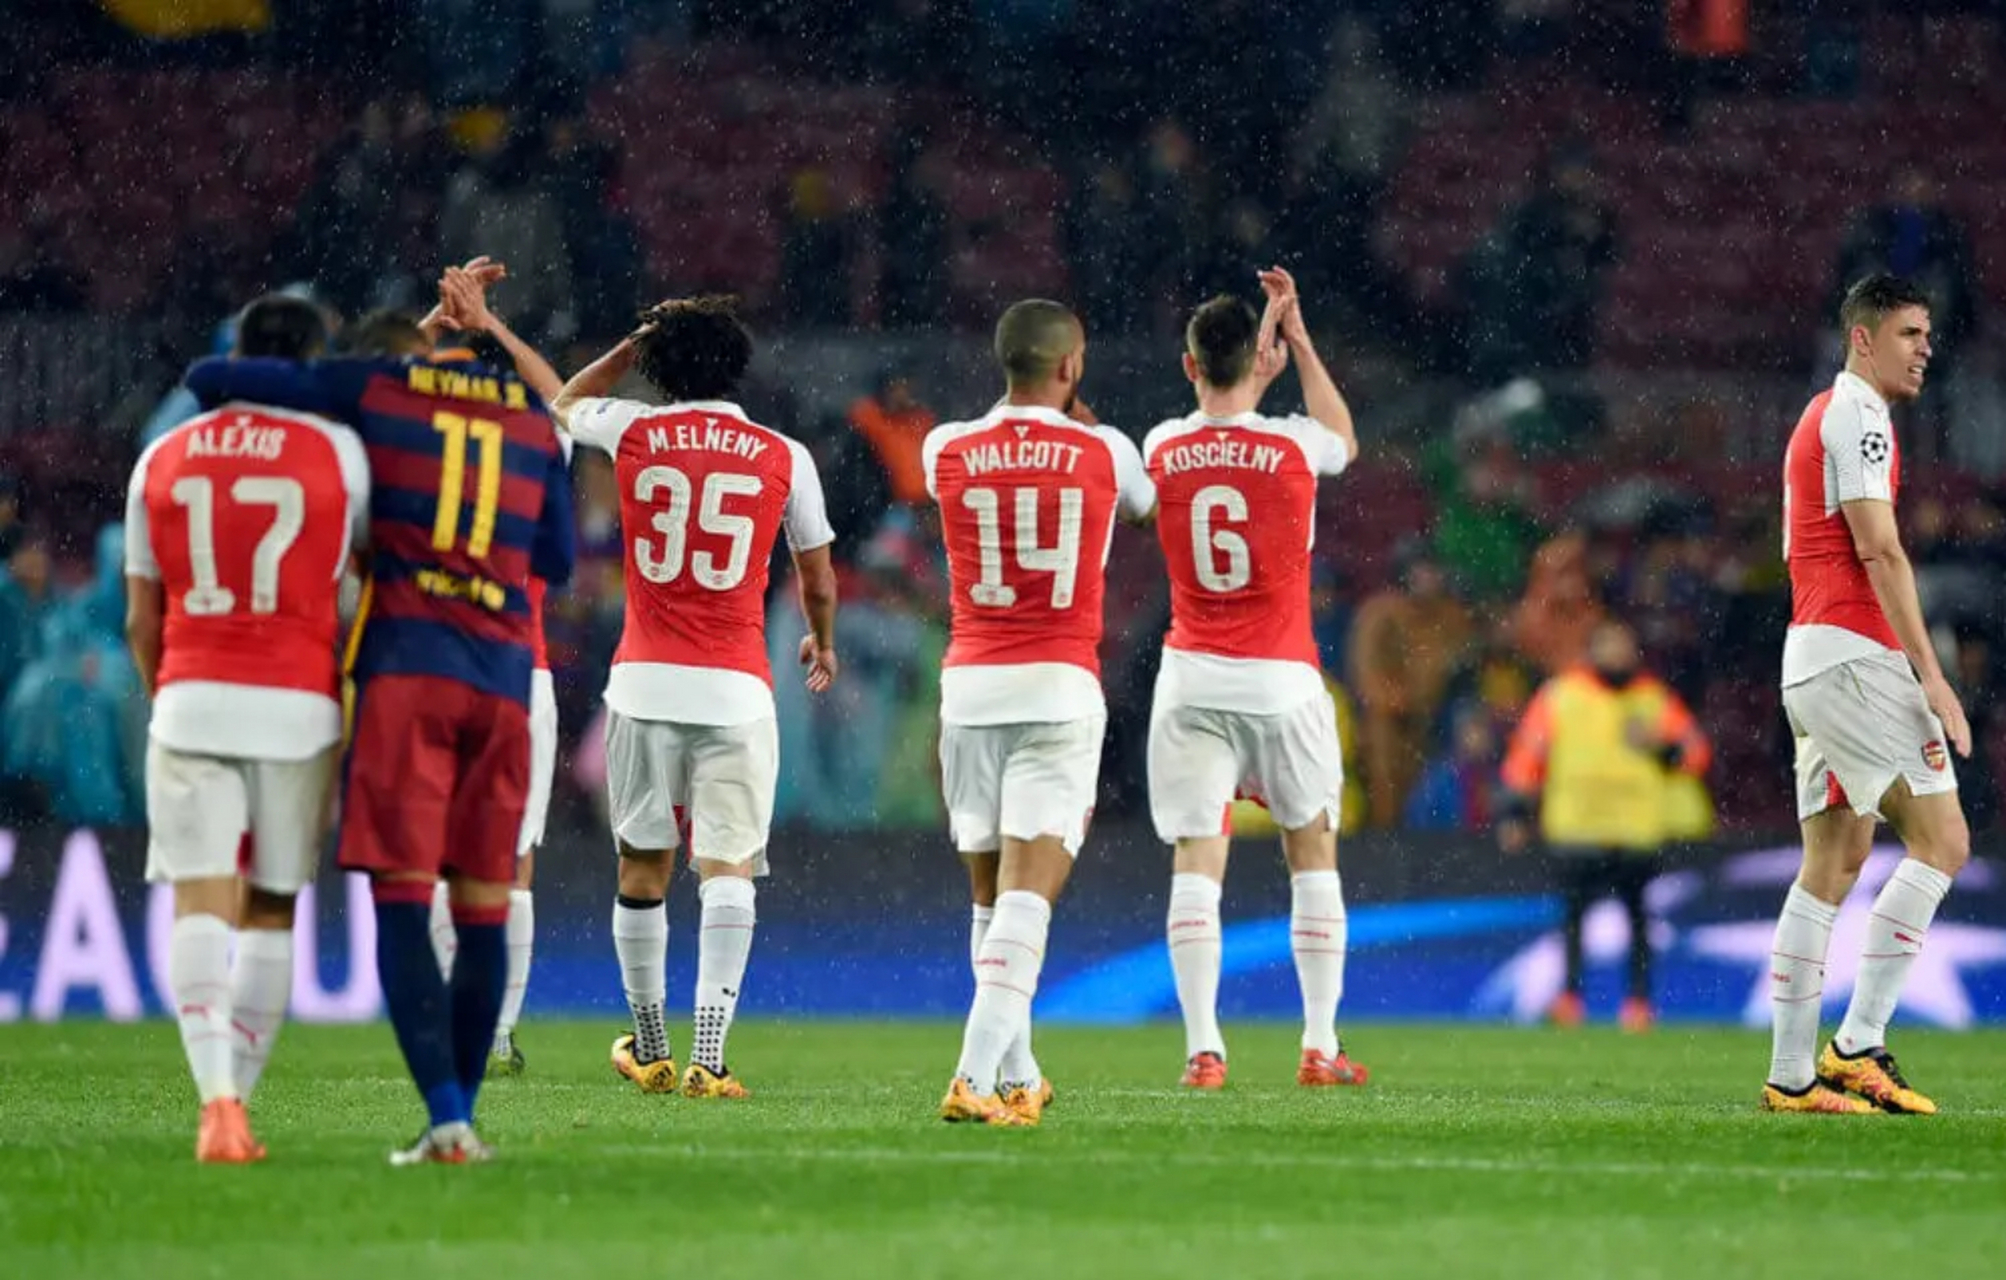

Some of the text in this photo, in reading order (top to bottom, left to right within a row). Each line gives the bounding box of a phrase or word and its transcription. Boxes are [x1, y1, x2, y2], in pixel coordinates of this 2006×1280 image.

[408, 366, 500, 403] NEYMAR
[186, 425, 285, 460] ALEXIS
[432, 410, 502, 558] 11
[962, 440, 1083, 476] WALCOTT
[1163, 440, 1284, 475] KOSCIELNY
[172, 476, 305, 616] 17
[634, 465, 764, 591] 35
[962, 487, 1083, 609] 14
[1191, 485, 1251, 593] 6
